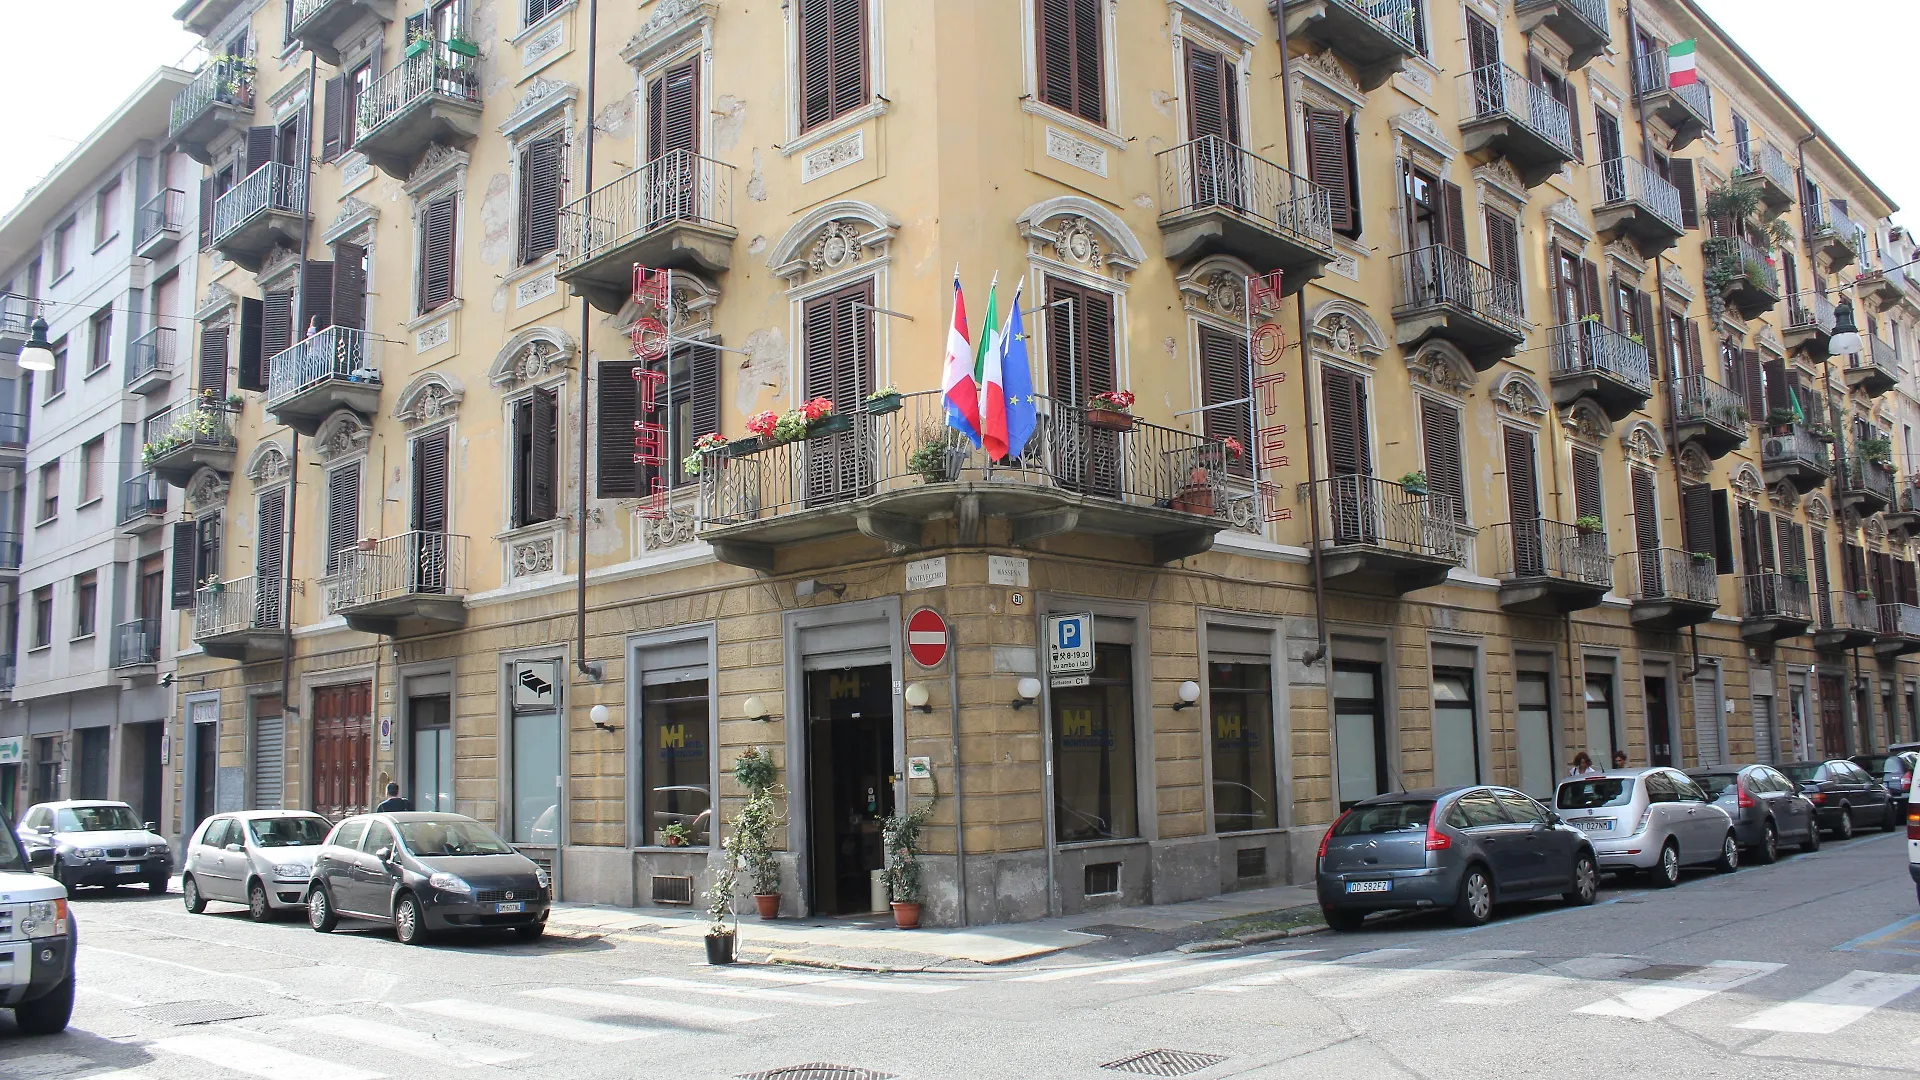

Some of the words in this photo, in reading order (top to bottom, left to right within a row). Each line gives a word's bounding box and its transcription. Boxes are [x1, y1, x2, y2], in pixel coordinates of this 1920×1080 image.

[1249, 268, 1292, 523] HOTEL
[907, 572, 944, 582] MONTEVECCHIO
[1062, 623, 1076, 645] P
[1063, 709, 1092, 736] MH
[1217, 715, 1240, 738] MH
[660, 724, 684, 748] MH
[1363, 881, 1387, 891] 582FZ
